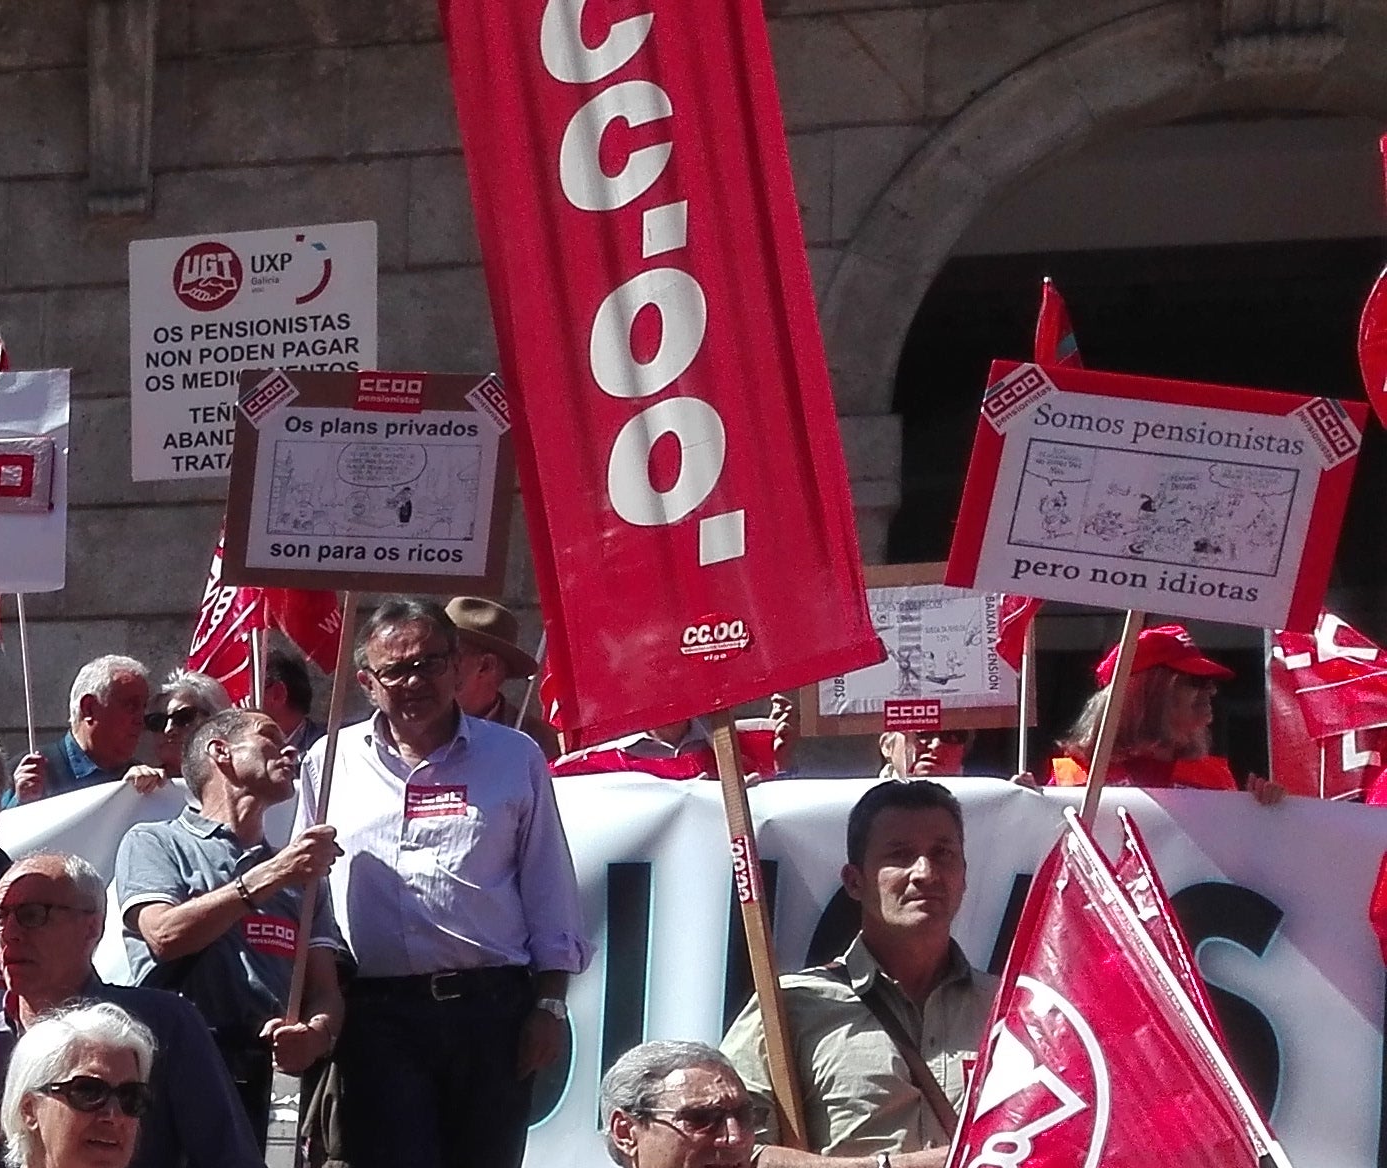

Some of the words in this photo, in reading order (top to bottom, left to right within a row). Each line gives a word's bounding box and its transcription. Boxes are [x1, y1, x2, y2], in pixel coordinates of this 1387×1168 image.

[182, 252, 234, 280] UGT
[251, 253, 292, 273] UXP
[153, 327, 183, 344] OS
[191, 313, 351, 341] PENSIONISTAS
[146, 350, 191, 368] NON
[199, 345, 275, 364] PODEN
[282, 337, 359, 358] PAGAR
[145, 375, 175, 392] OS
[246, 378, 288, 413] CCOO
[359, 378, 423, 394] CCOO
[987, 372, 1039, 414] CCOO
[189, 401, 237, 424] TEÑ
[995, 384, 1053, 429] pensionistas
[285, 416, 313, 433] Os
[320, 416, 378, 436] plans
[385, 419, 479, 438] privados
[1034, 402, 1125, 435] Somos
[1130, 420, 1305, 456] pensionistas
[1314, 402, 1353, 453] CCOO
[270, 543, 310, 558] son
[318, 545, 367, 563] para
[374, 547, 400, 561] os
[407, 544, 463, 563] ricos
[1011, 555, 1080, 580] pero
[1089, 568, 1148, 589] non
[1157, 570, 1259, 603] idiotas
[985, 596, 997, 635] BAIXAN
[986, 646, 999, 691] PENSIÓN
[887, 705, 939, 717] CCOO
[247, 923, 296, 941] CCOO
